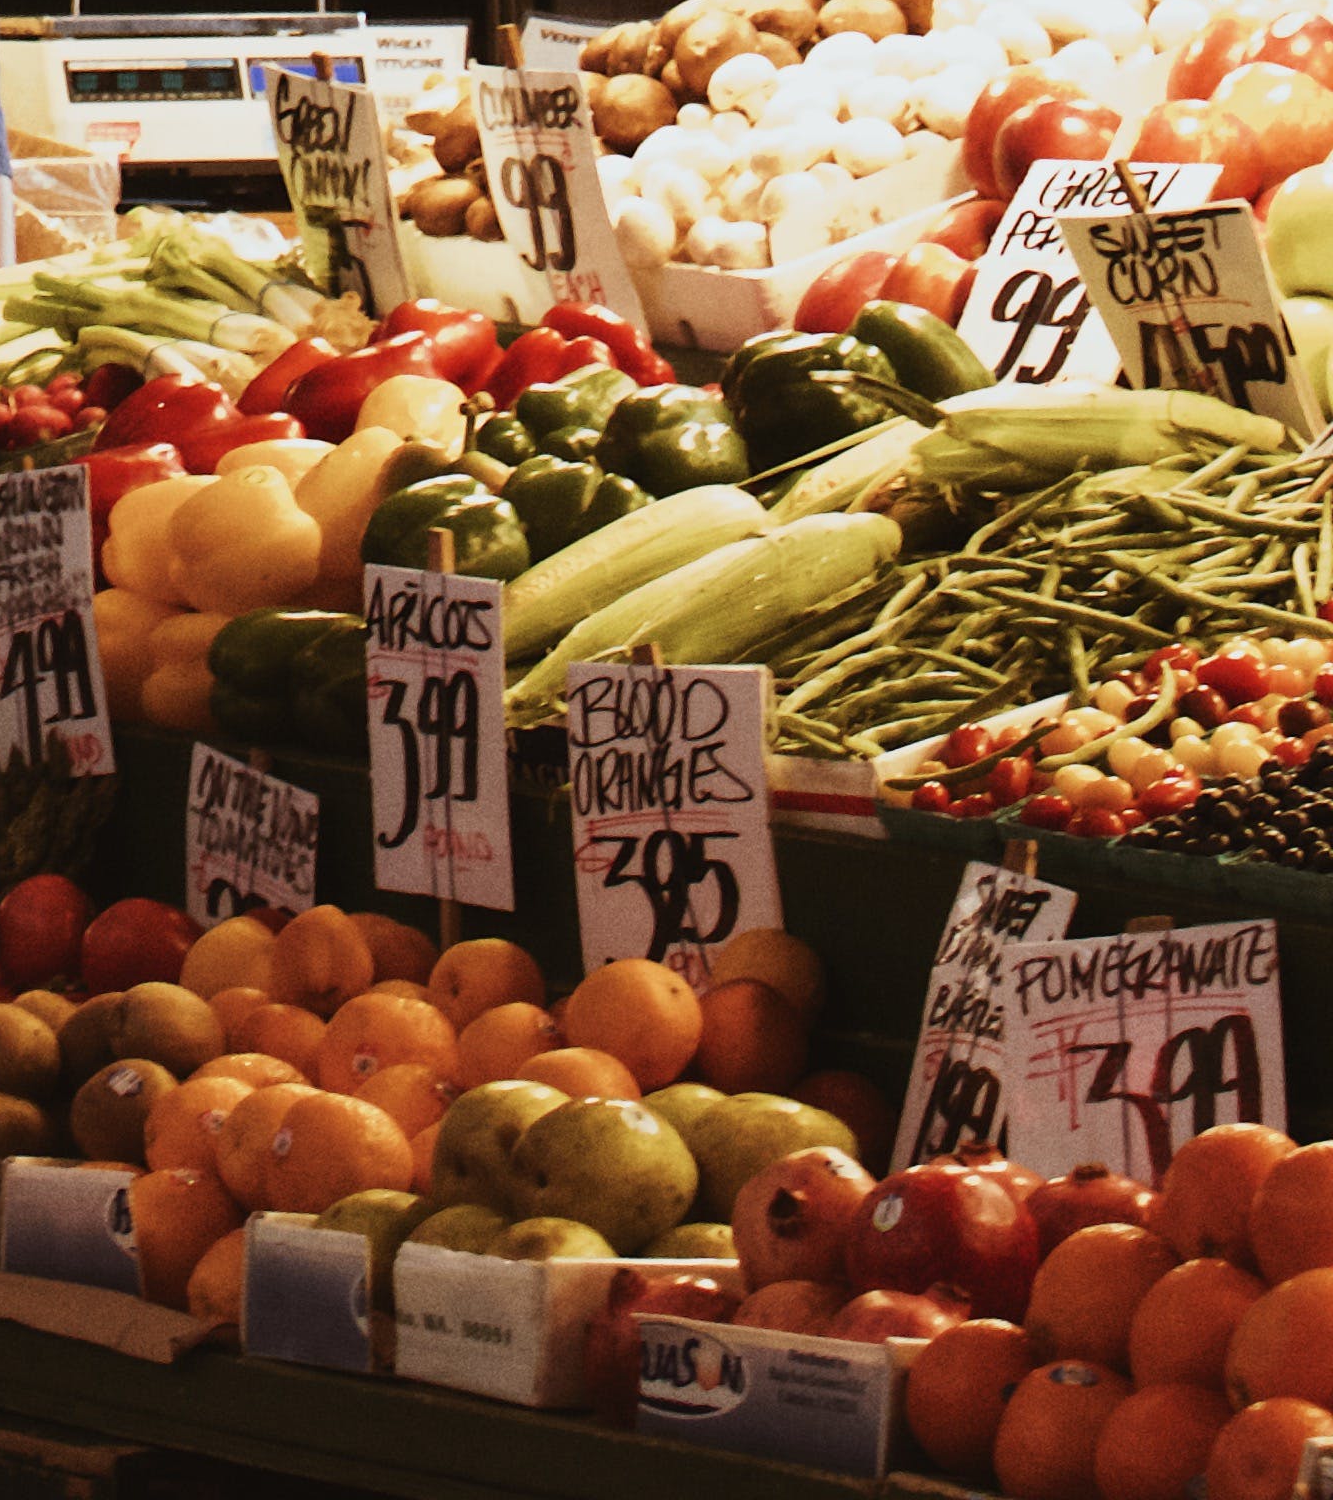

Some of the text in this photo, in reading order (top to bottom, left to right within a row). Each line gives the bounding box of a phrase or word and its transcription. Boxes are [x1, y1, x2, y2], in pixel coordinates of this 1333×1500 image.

[500, 153, 577, 273] 99
[1088, 207, 1242, 265] SWEET
[569, 677, 729, 748] BLOOD
[573, 740, 754, 816] ORANGES
[1012, 925, 1279, 1016] POMEGRANATE
